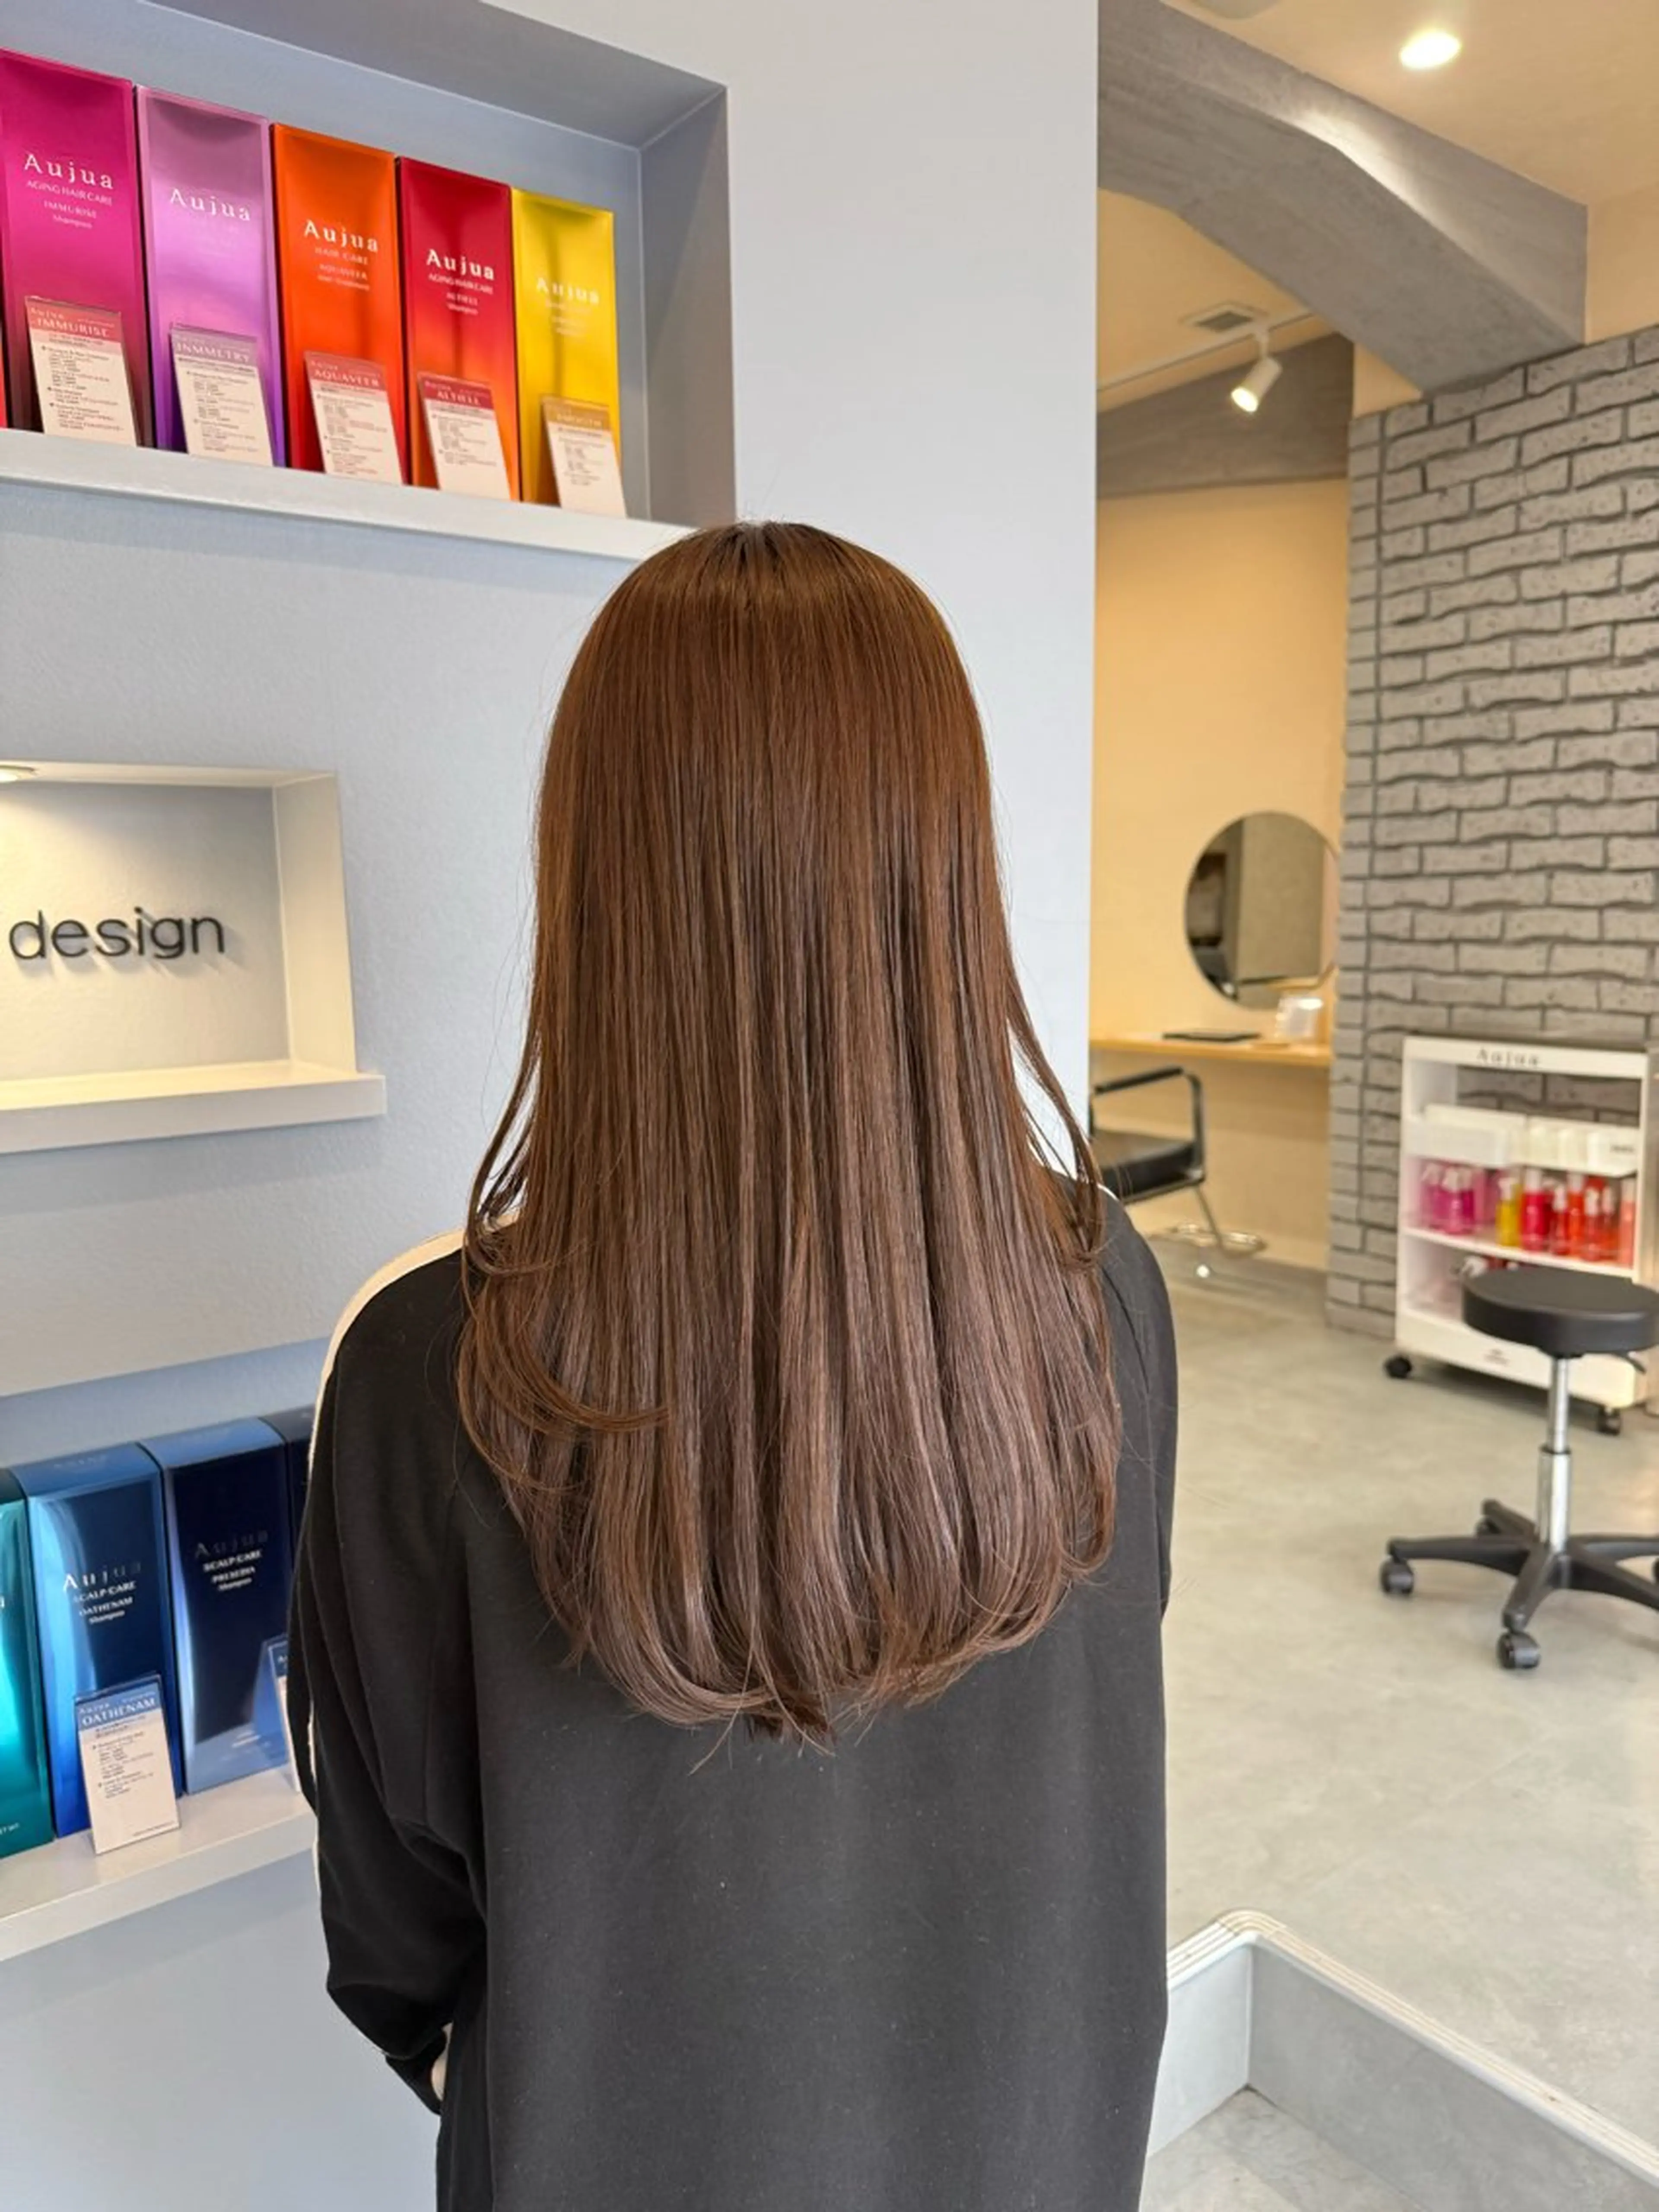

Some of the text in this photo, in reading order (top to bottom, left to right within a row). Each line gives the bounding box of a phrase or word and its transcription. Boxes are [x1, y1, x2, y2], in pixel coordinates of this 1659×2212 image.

[24, 154, 113, 189] Aujua
[170, 188, 250, 221] Aujua
[304, 219, 378, 253] Aujua
[426, 248, 495, 281] Aujua
[536, 277, 600, 305] Aujua
[9, 906, 224, 960] design
[82, 1697, 155, 1726] OATHENAM
